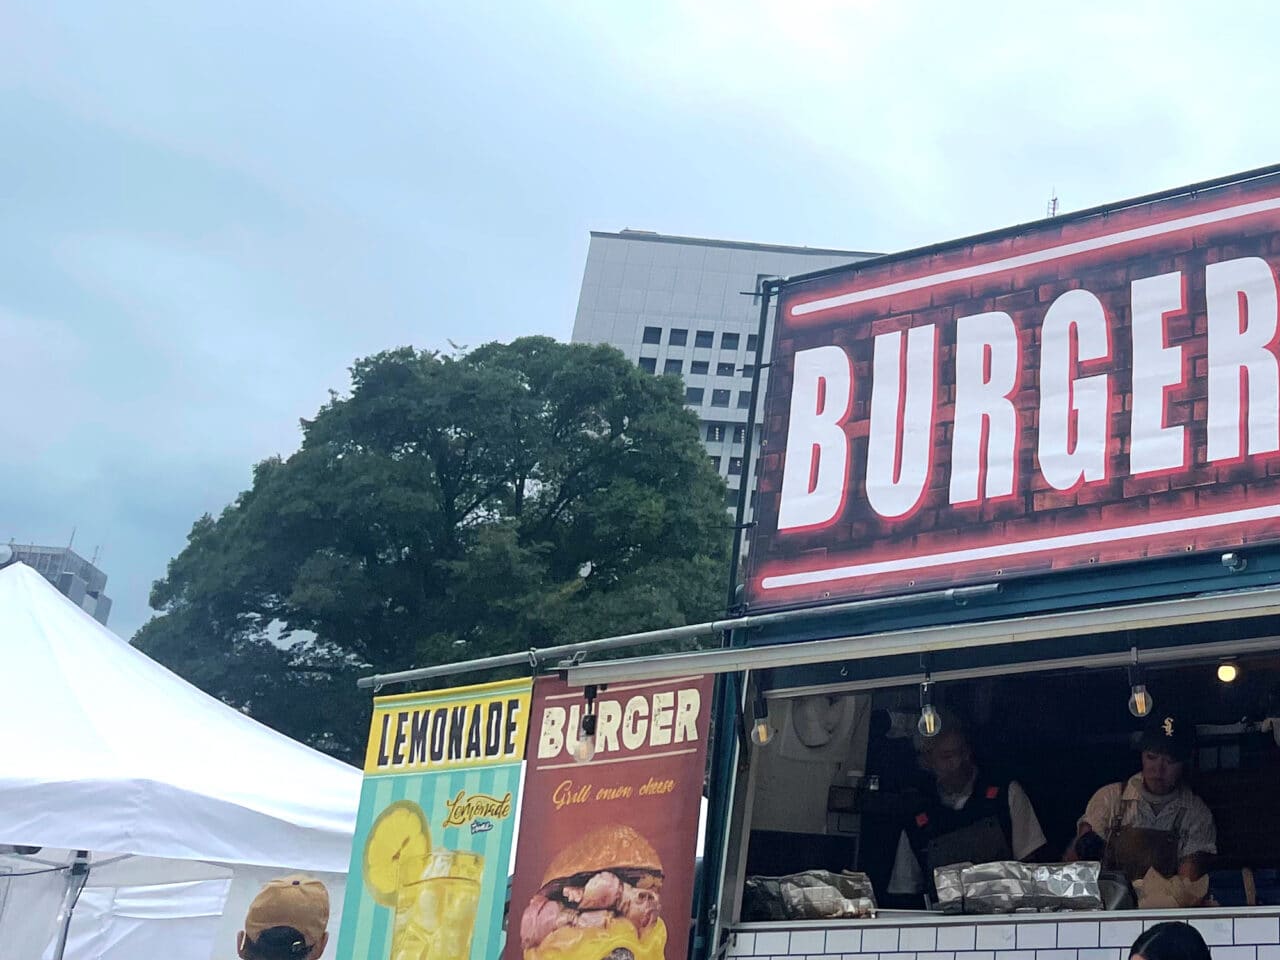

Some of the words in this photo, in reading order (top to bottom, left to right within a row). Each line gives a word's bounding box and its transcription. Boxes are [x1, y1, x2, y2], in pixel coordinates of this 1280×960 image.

[377, 698, 521, 767] LEMONADE
[537, 688, 700, 760] BURGER
[442, 789, 512, 828] Lemonade
[552, 780, 592, 810] Grill
[596, 786, 632, 801] onion
[638, 777, 676, 796] cheese
